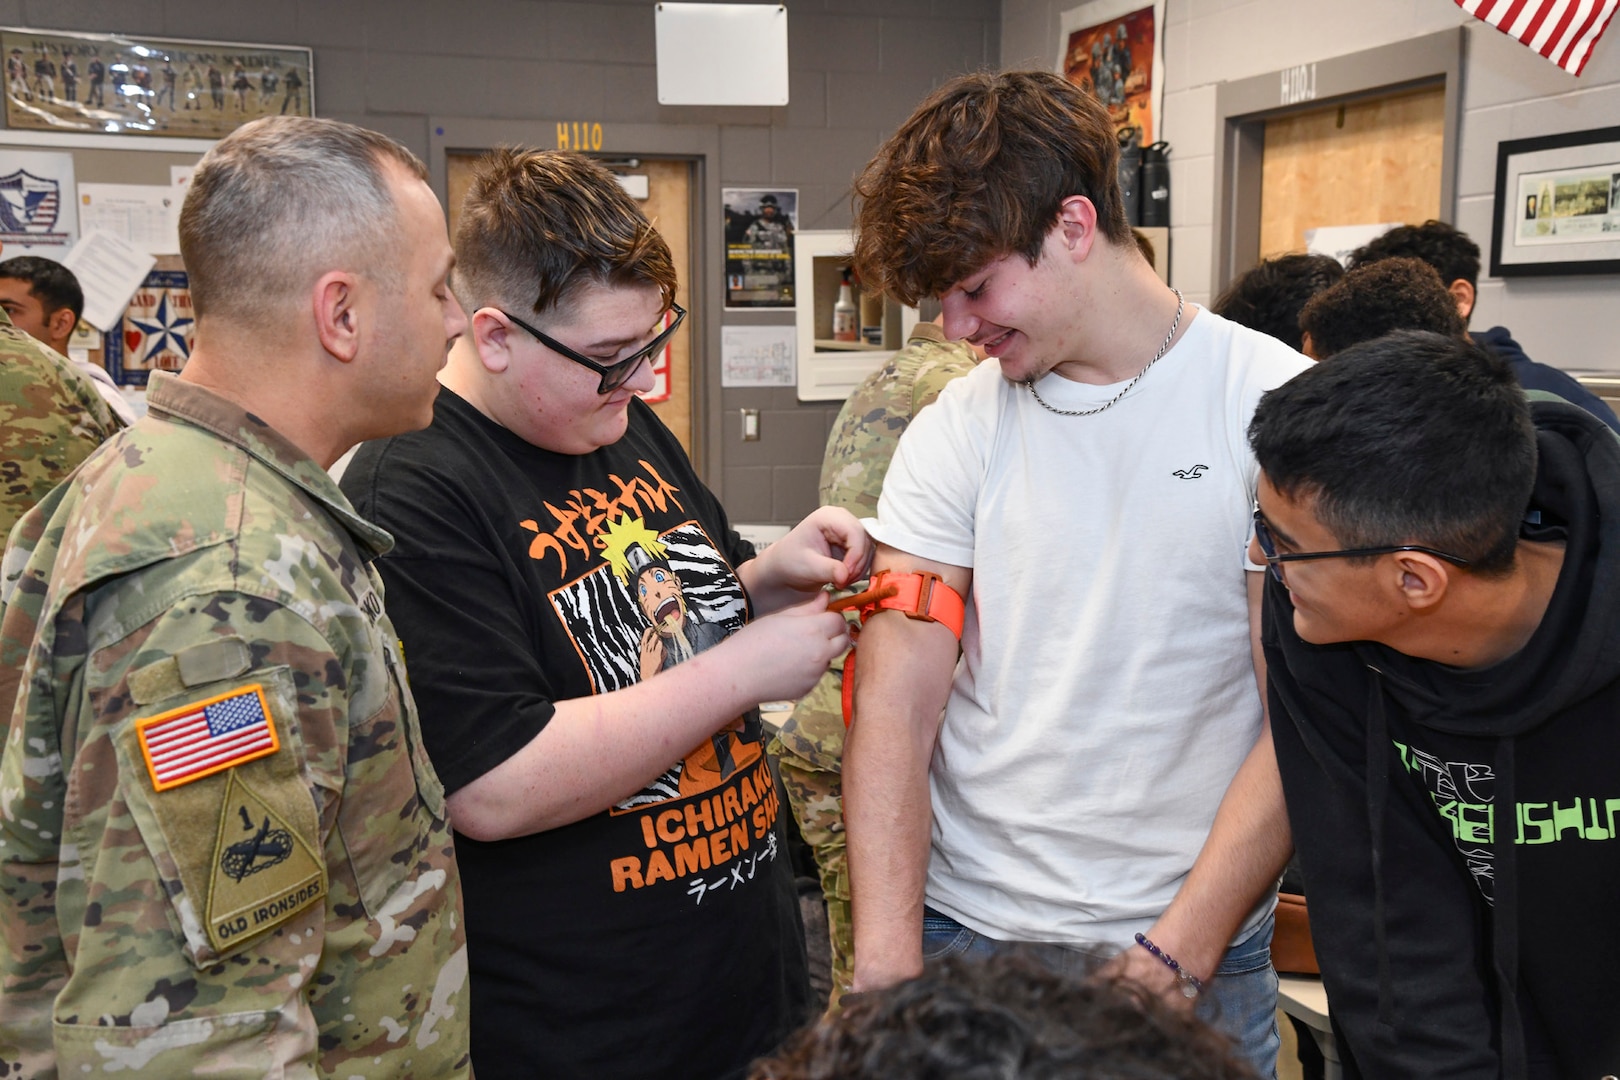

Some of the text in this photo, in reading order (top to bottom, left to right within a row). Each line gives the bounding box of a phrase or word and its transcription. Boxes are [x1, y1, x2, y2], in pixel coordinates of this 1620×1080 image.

[557, 121, 602, 151] H110
[238, 805, 255, 831] 1
[641, 754, 773, 849] ICHIRAKU
[610, 818, 749, 893] RAMEN
[218, 881, 320, 939] OLD IRONSIDES
